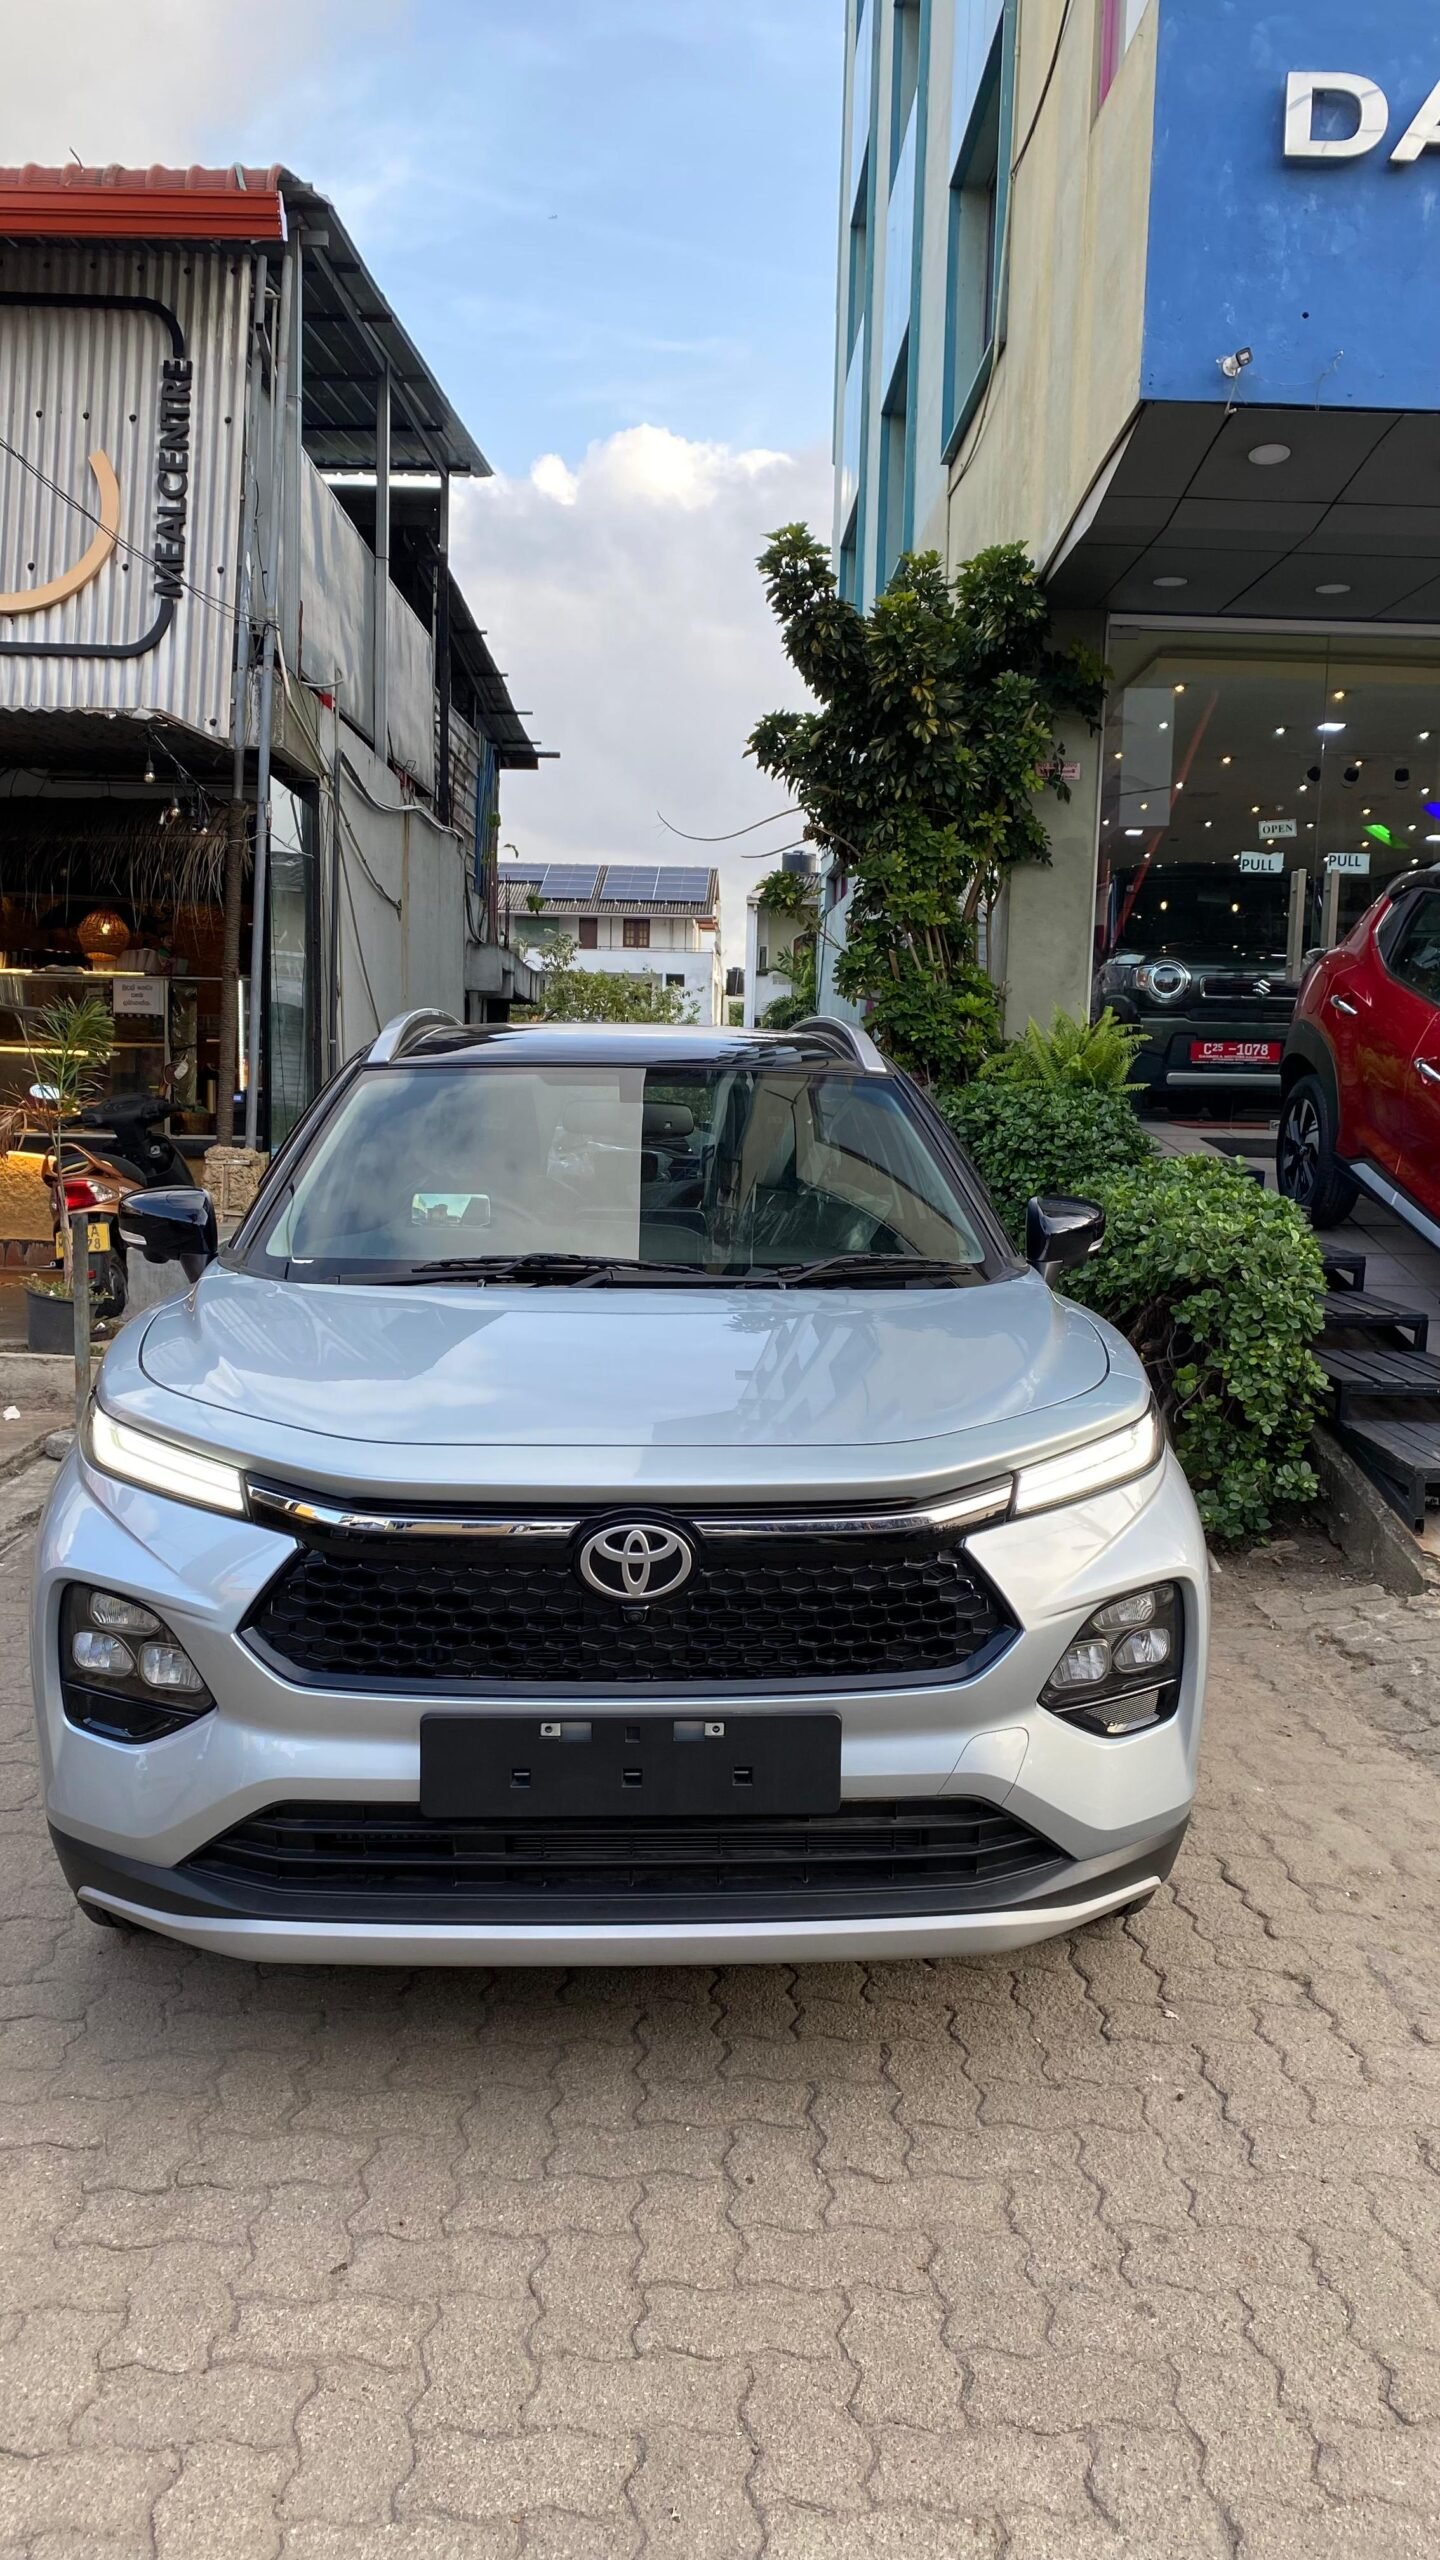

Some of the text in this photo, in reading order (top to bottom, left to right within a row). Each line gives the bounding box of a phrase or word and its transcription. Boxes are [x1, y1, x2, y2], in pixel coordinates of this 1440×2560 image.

[1262, 824, 1293, 834] OPEN
[1241, 859, 1274, 871] PULL
[1328, 855, 1361, 866] PULL
